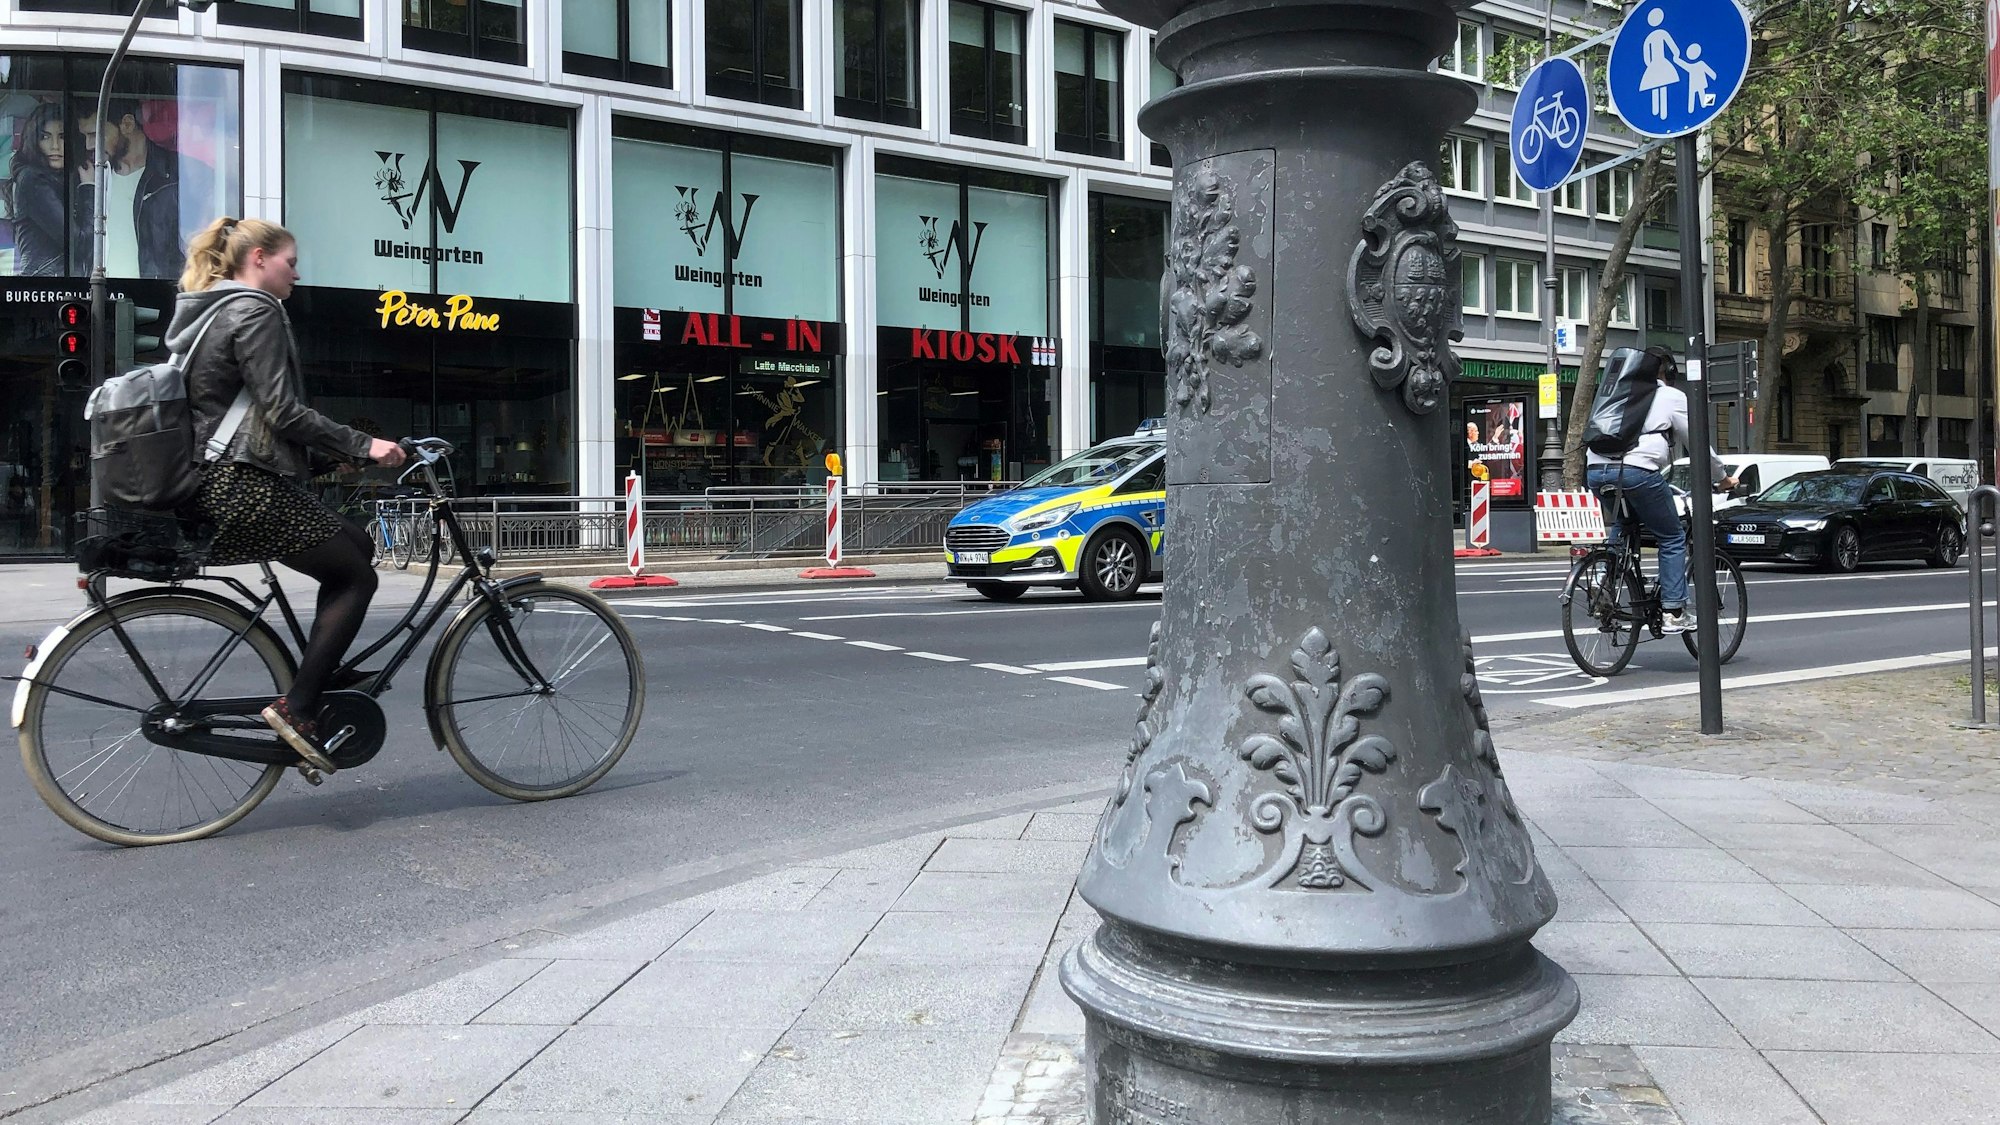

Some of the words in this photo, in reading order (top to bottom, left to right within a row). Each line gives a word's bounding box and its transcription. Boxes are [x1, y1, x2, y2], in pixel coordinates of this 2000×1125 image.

[374, 239, 483, 265] Weingarten
[675, 265, 762, 288] Weingrten
[919, 287, 990, 307] Weingten
[375, 290, 441, 329] Peter
[443, 294, 500, 332] Pane
[681, 311, 752, 348] ALL
[761, 332, 775, 342] -
[786, 318, 822, 352] IN
[912, 328, 1021, 364] KIOSK
[754, 360, 775, 371] Latte
[778, 361, 820, 374] Macchiato
[741, 383, 780, 414] JOHNNIE
[793, 418, 824, 442] WALKER
[1470, 443, 1489, 452] Köln
[1489, 442, 1513, 453] bringt
[1478, 452, 1521, 460] zusammen
